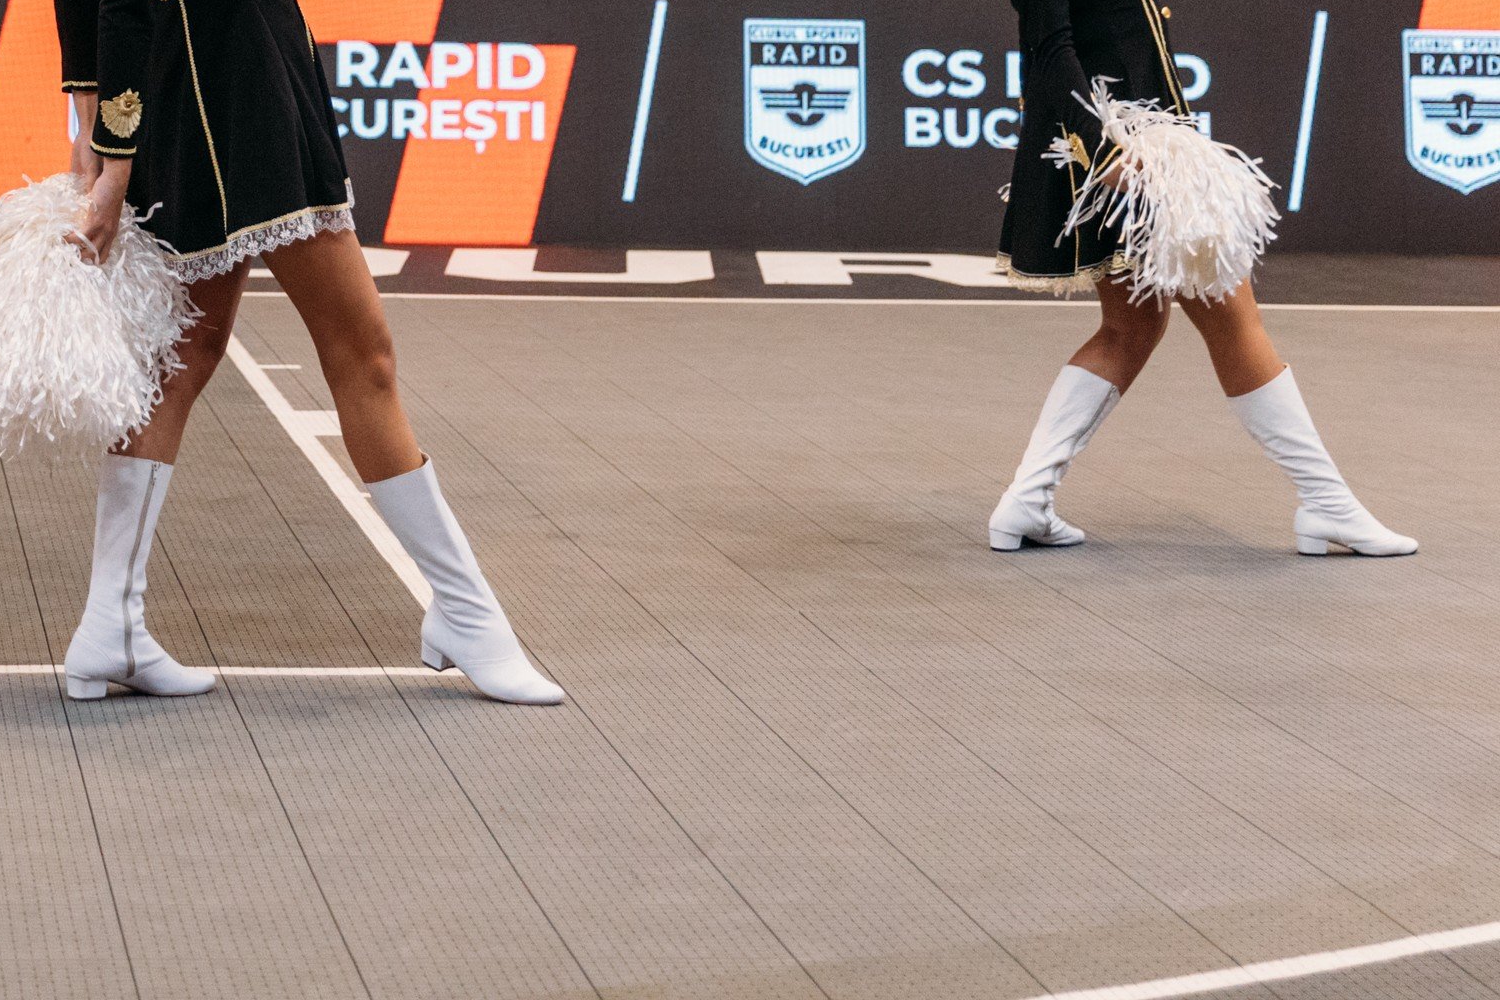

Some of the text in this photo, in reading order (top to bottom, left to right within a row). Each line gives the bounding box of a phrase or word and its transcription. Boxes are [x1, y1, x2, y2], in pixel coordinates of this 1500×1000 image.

[336, 40, 546, 90] RAPID
[762, 43, 848, 66] RAPID
[902, 48, 987, 99] CS
